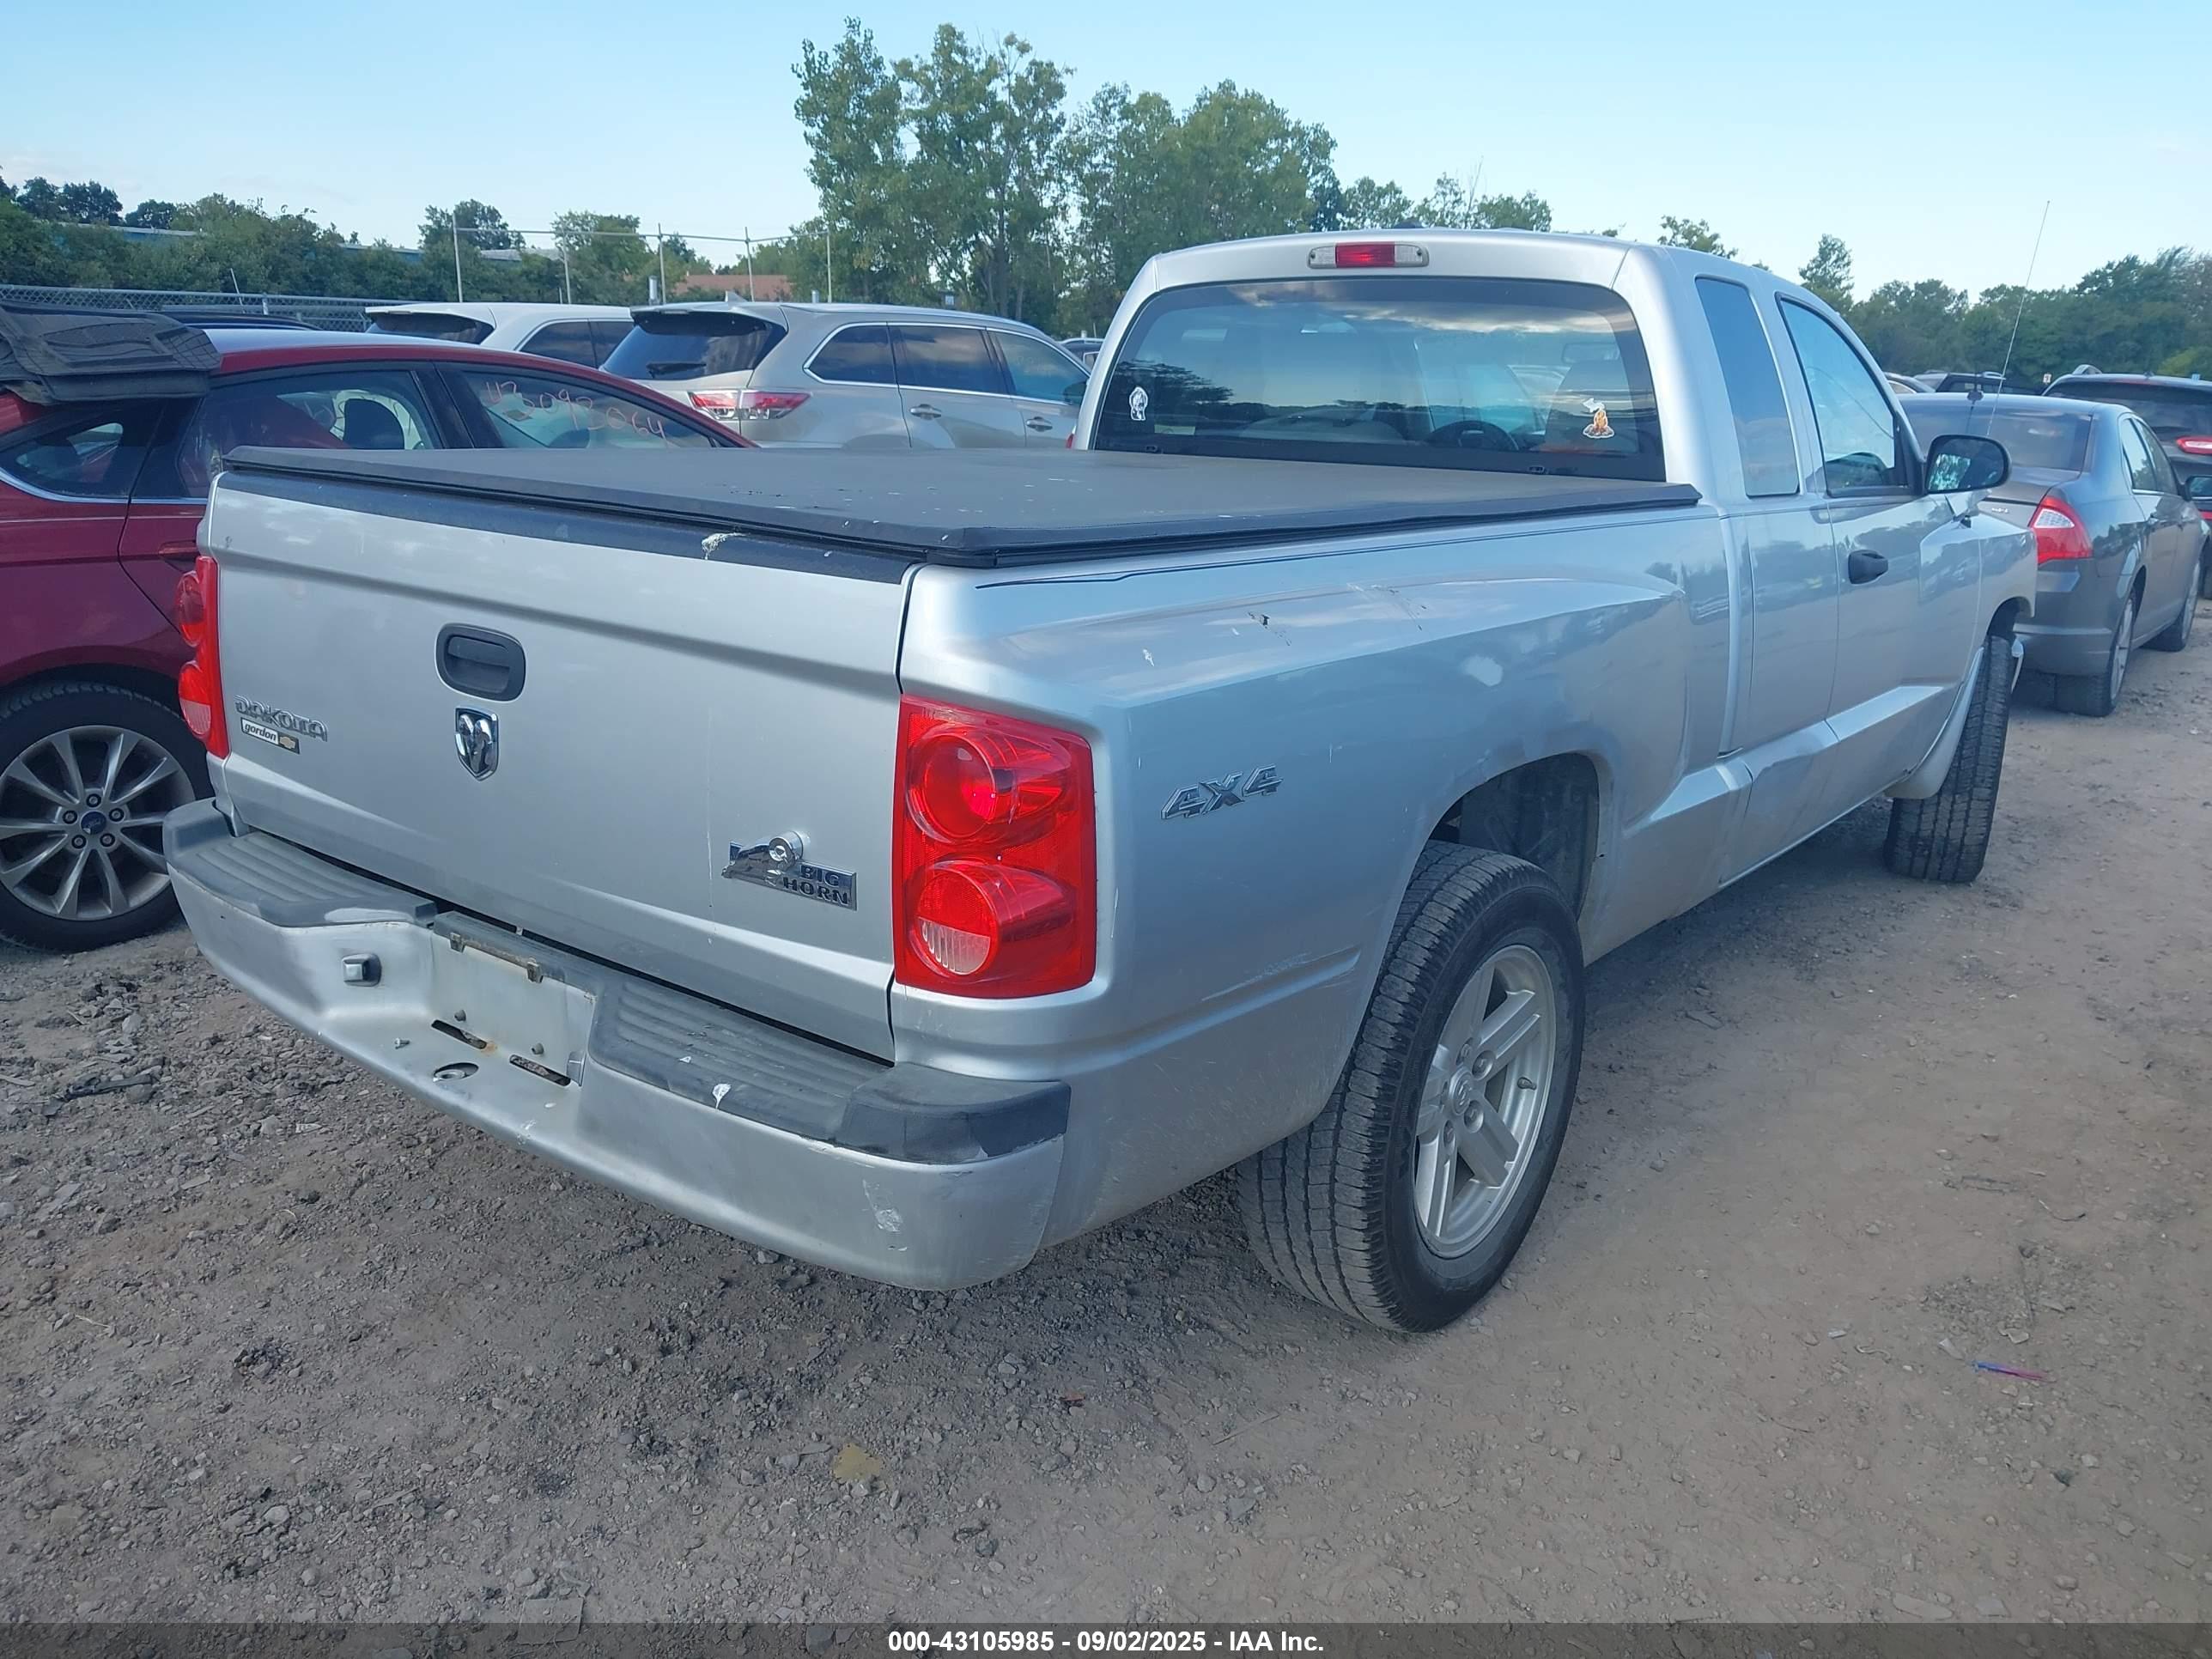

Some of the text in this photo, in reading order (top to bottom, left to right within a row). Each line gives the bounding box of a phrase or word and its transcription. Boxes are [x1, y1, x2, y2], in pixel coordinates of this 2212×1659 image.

[234, 695, 328, 742] DAKOTA
[245, 722, 276, 741] gordon
[800, 864, 840, 888] BIG
[782, 876, 849, 906] HORN
